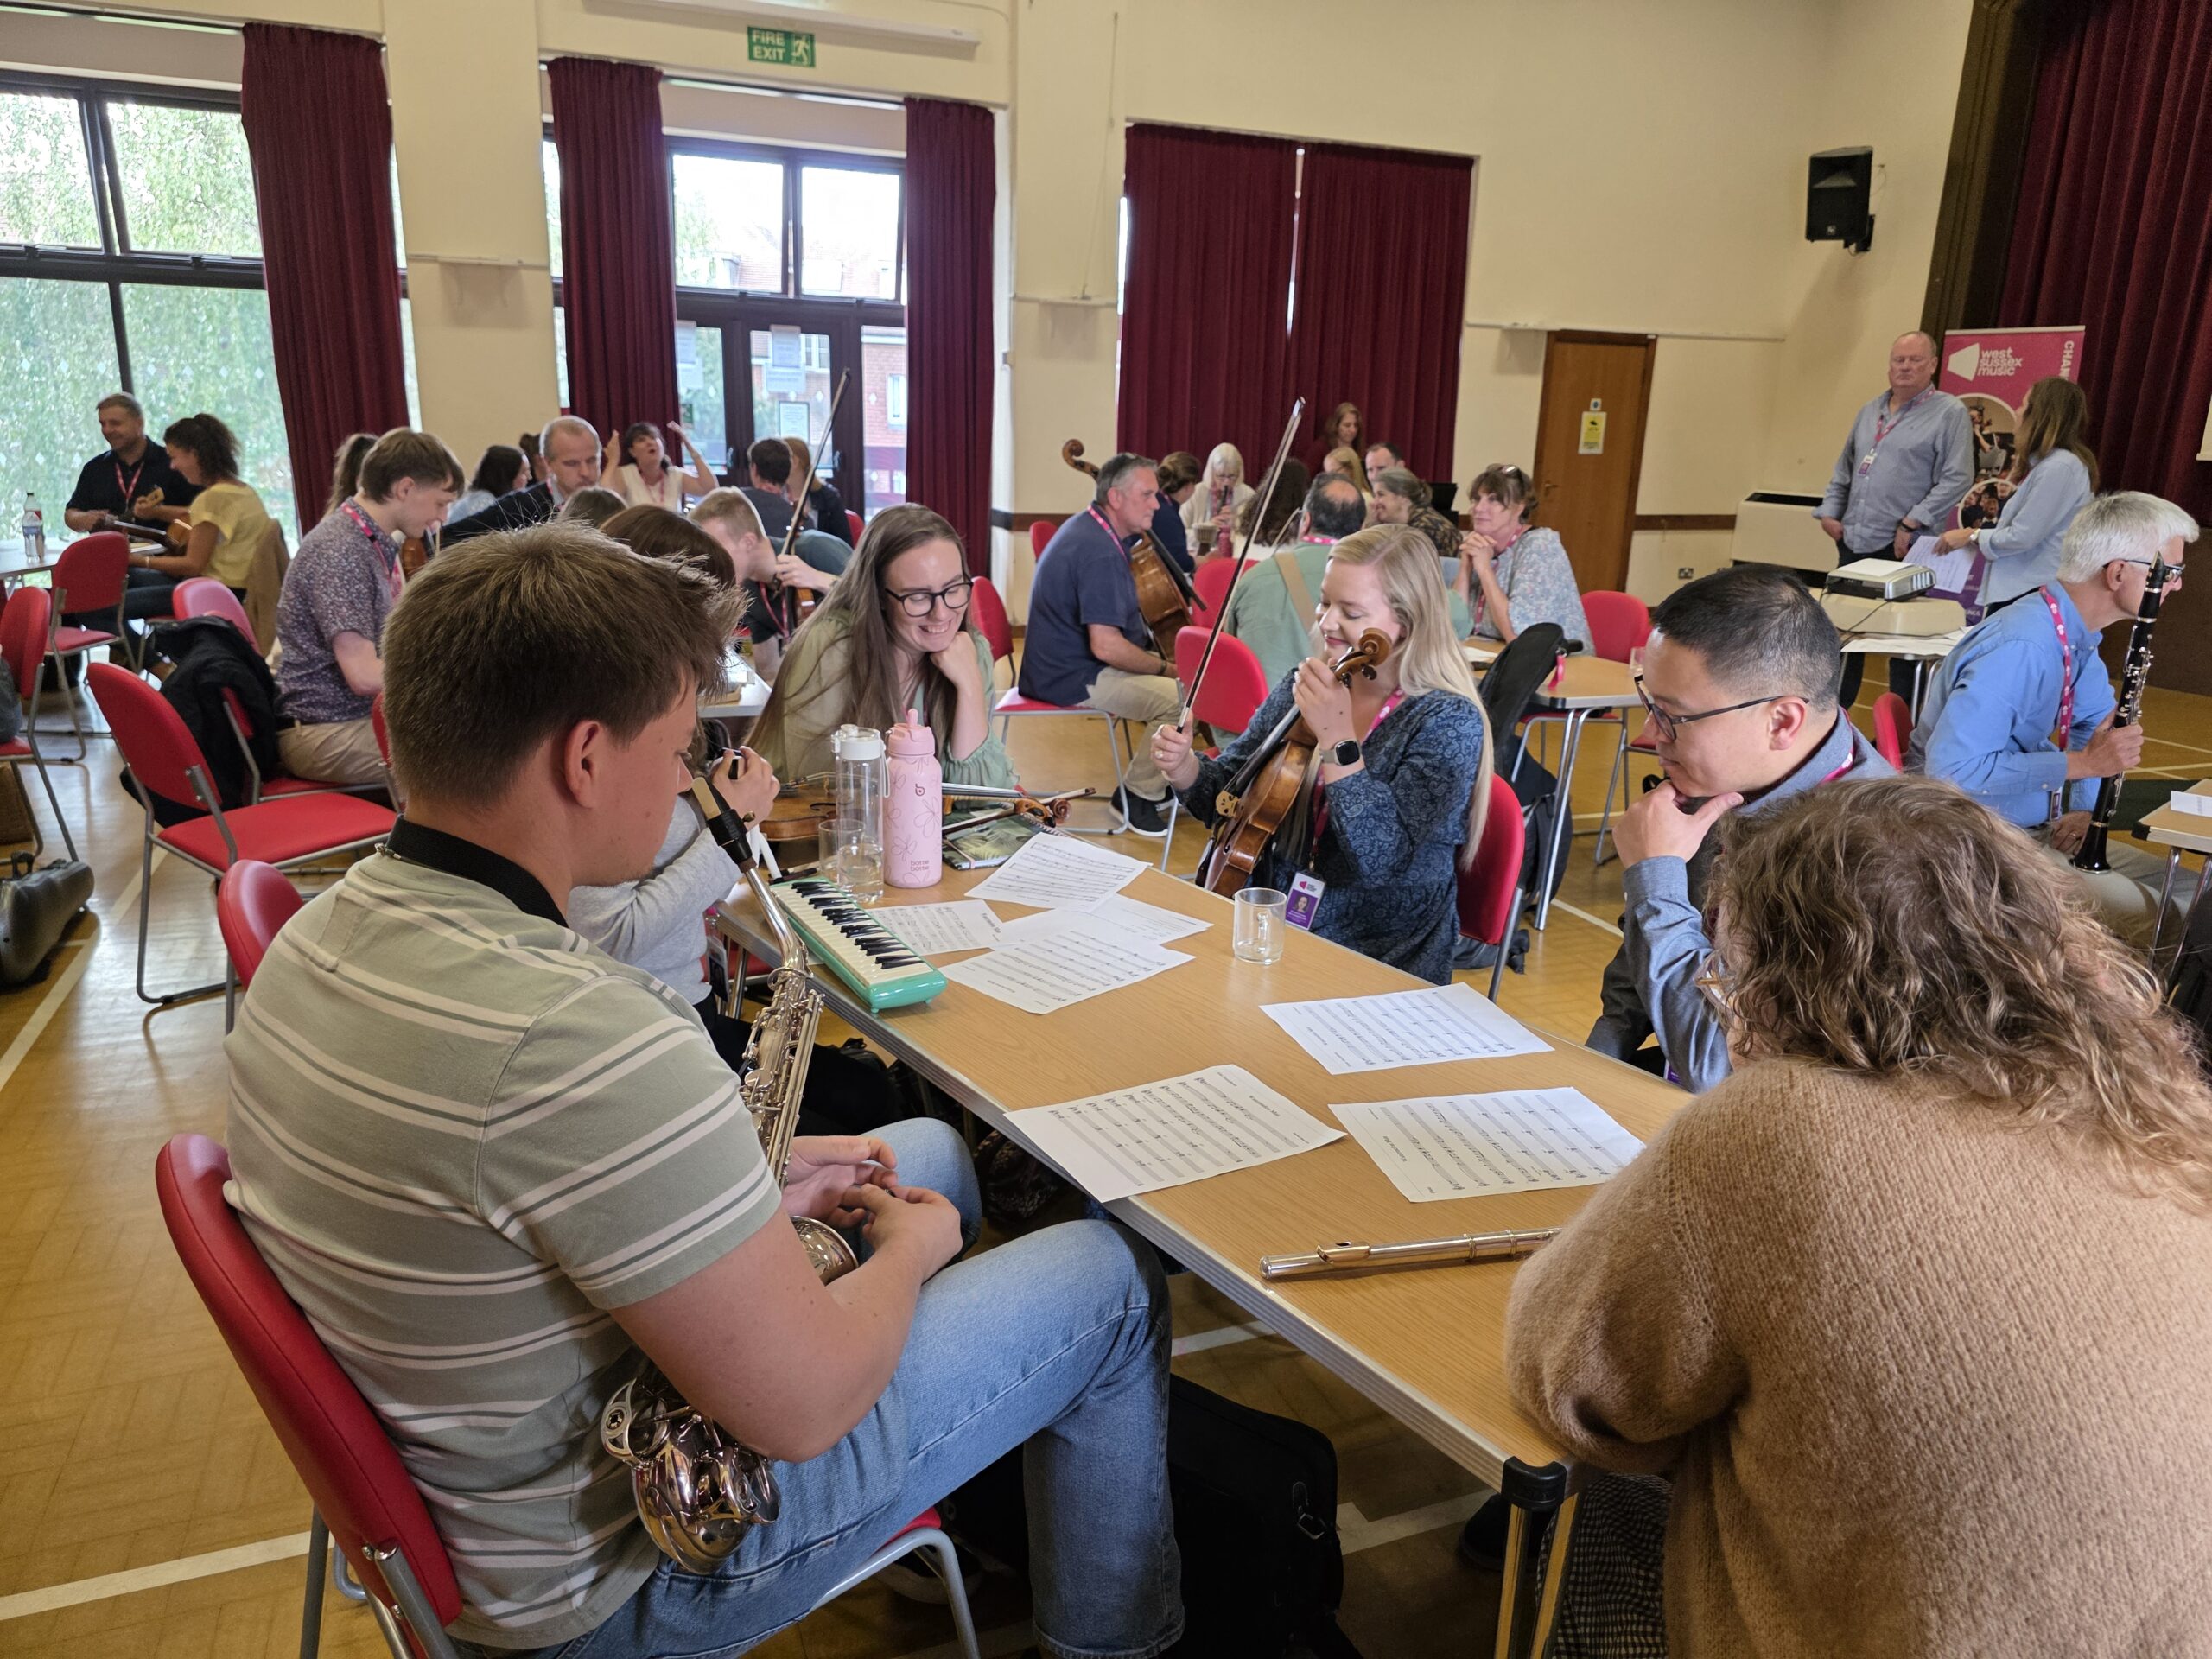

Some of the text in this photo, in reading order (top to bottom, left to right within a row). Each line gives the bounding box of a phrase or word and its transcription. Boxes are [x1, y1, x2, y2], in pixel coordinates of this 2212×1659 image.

[753, 29, 785, 47] FIRE
[753, 45, 786, 61] EXIT
[1980, 346, 2012, 359] west
[1980, 357, 2023, 367] sussex
[1977, 366, 2015, 376] music
